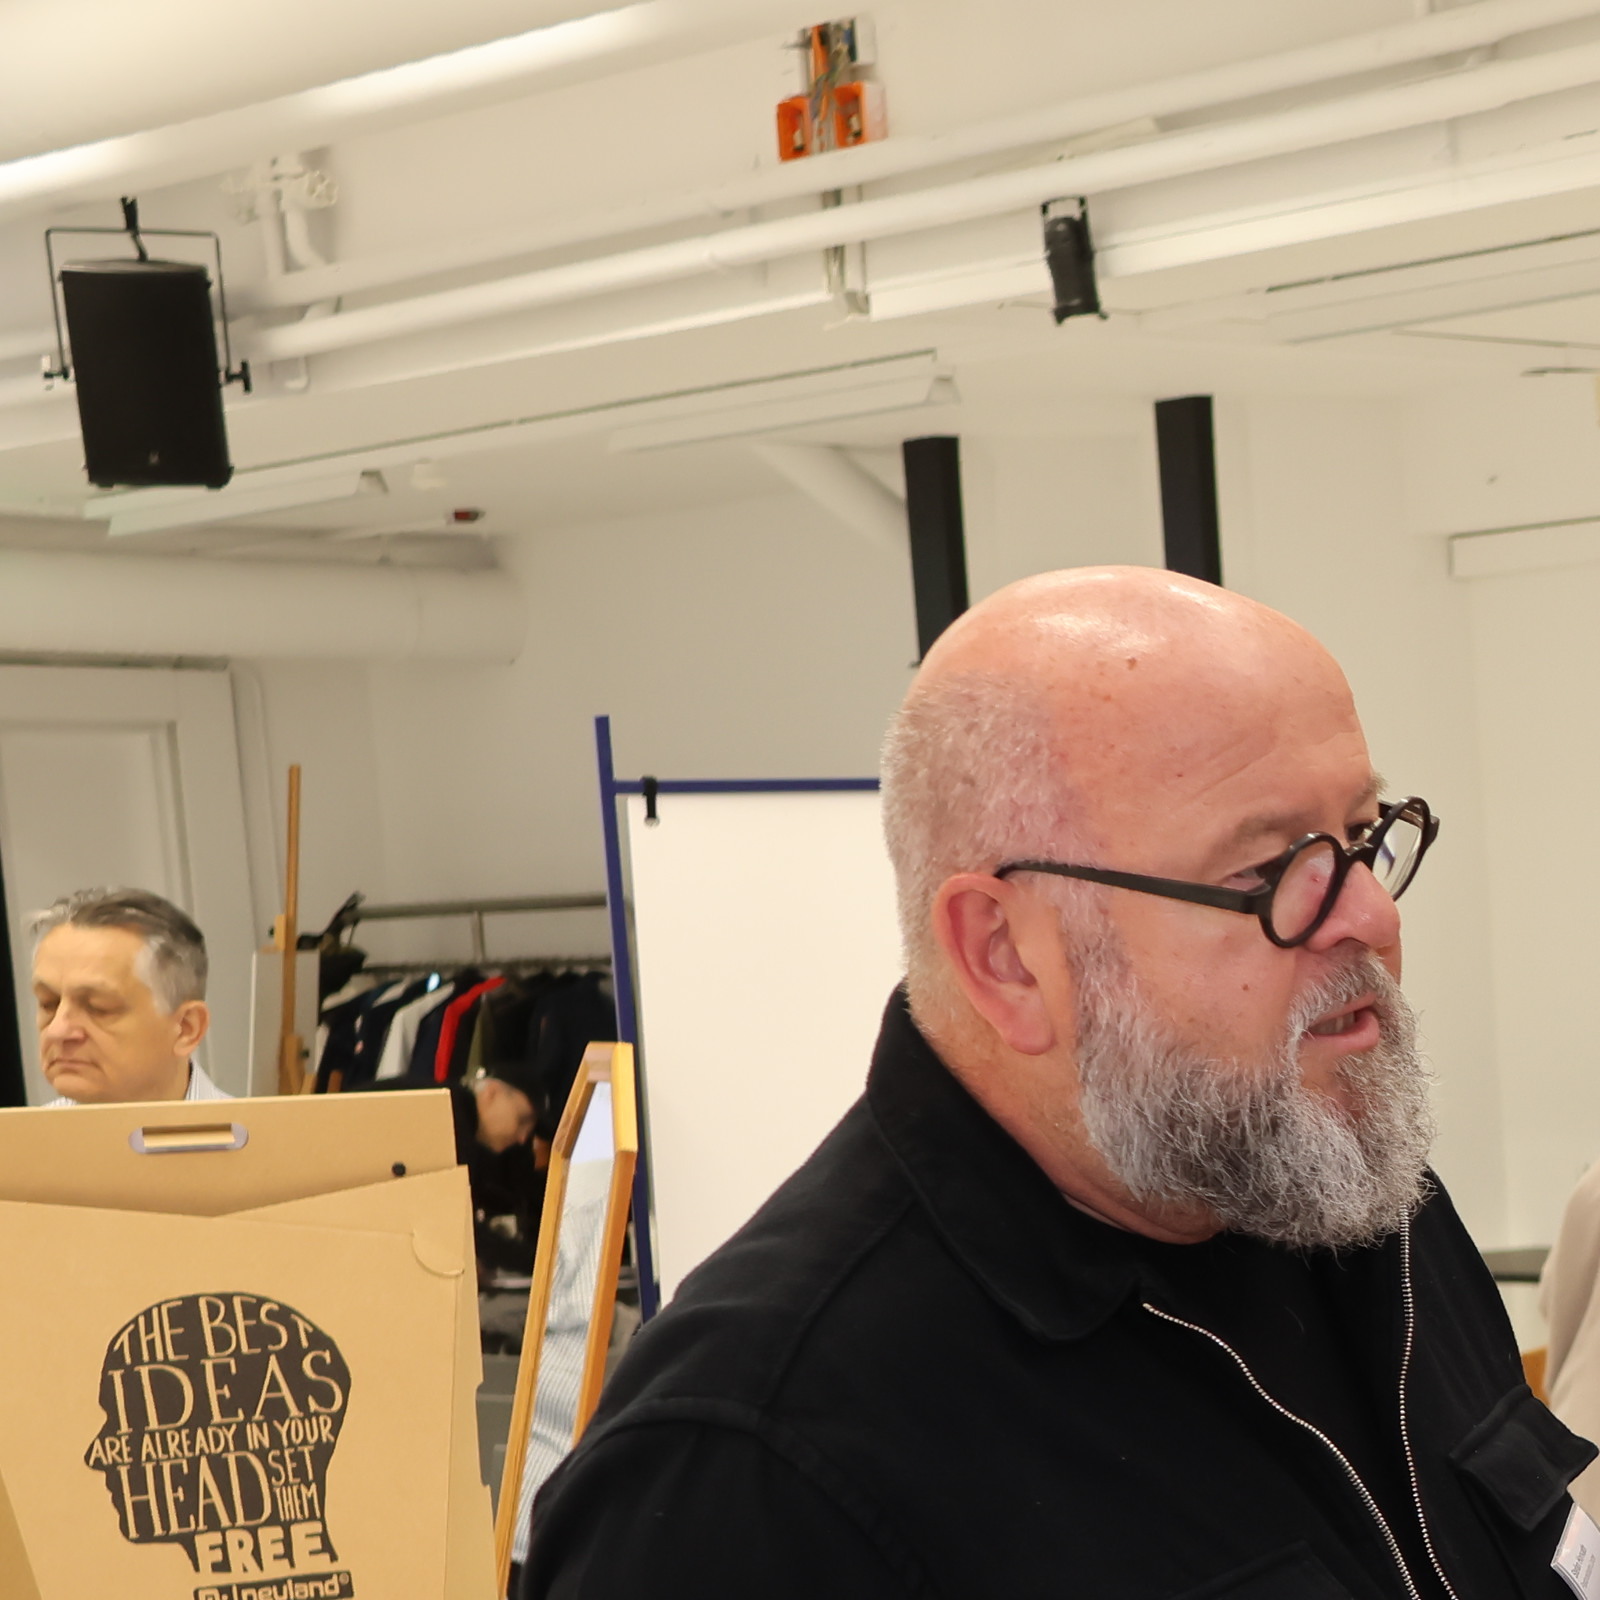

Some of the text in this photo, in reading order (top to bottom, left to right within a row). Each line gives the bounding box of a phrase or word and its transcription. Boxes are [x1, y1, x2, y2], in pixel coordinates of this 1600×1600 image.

[112, 1294, 314, 1365] THE BEST
[108, 1350, 343, 1434] IDEAS
[88, 1415, 336, 1467] ARE ALREADY IN YOUR
[116, 1446, 316, 1539] HEAD SET
[272, 1483, 322, 1521] THEM
[195, 1521, 332, 1573] FREE
